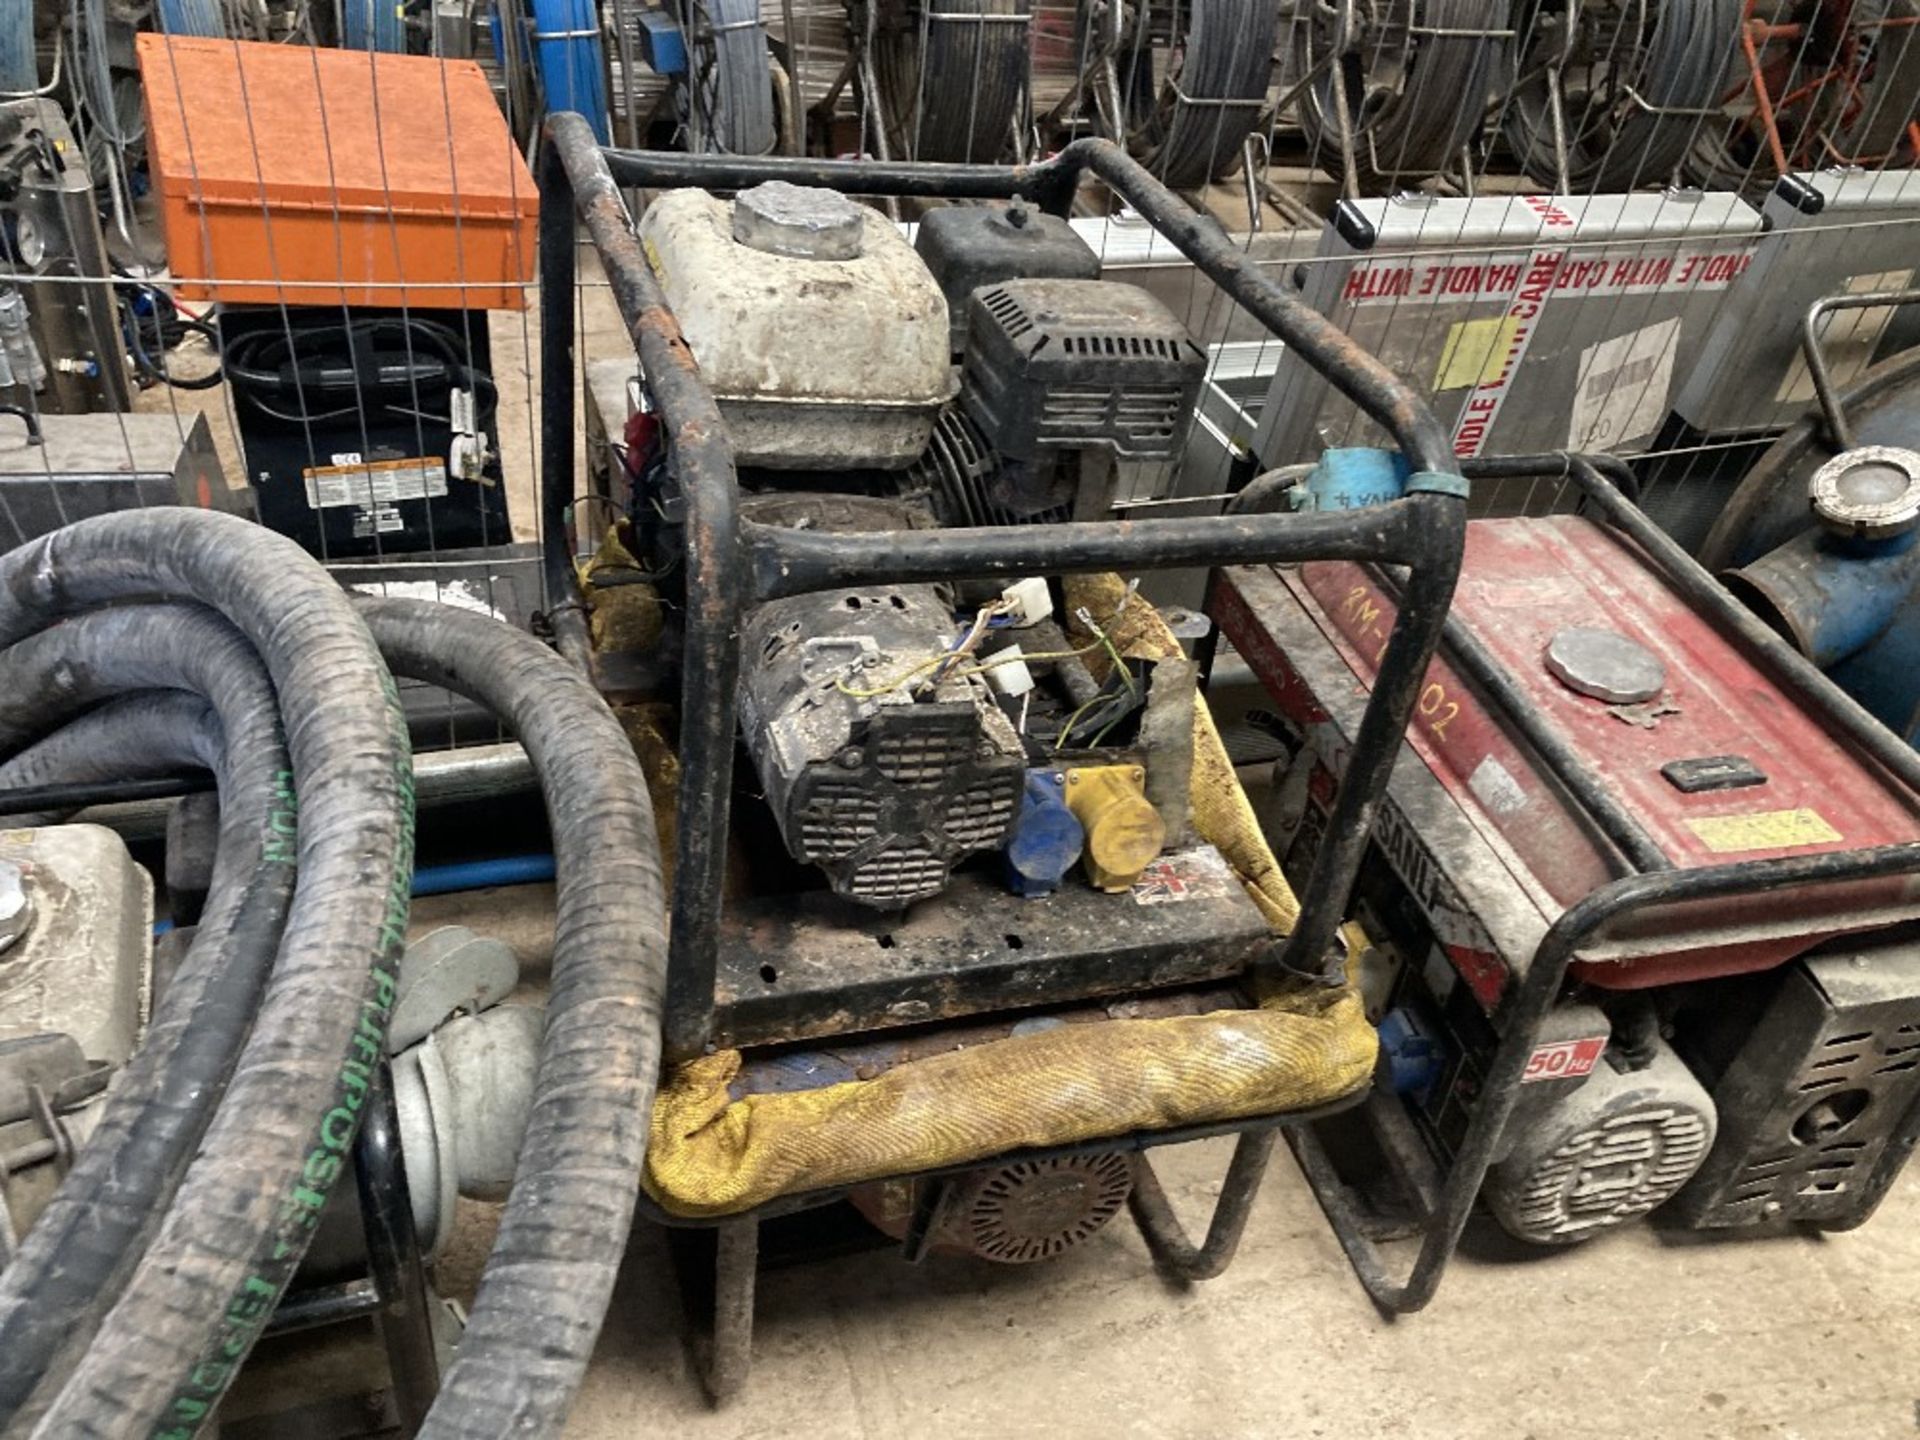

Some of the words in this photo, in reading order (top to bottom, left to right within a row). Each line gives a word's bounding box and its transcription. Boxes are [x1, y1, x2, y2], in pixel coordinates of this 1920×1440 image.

[1344, 266, 1414, 299] WITH
[1419, 264, 1522, 295] HANDLE
[1554, 259, 1609, 290] CAR
[1608, 254, 1674, 288] WITH
[1676, 254, 1752, 284] NDLE
[1454, 397, 1497, 458] NDLE
[1510, 251, 1564, 319] CARE
[1525, 1051, 1568, 1074] 50
